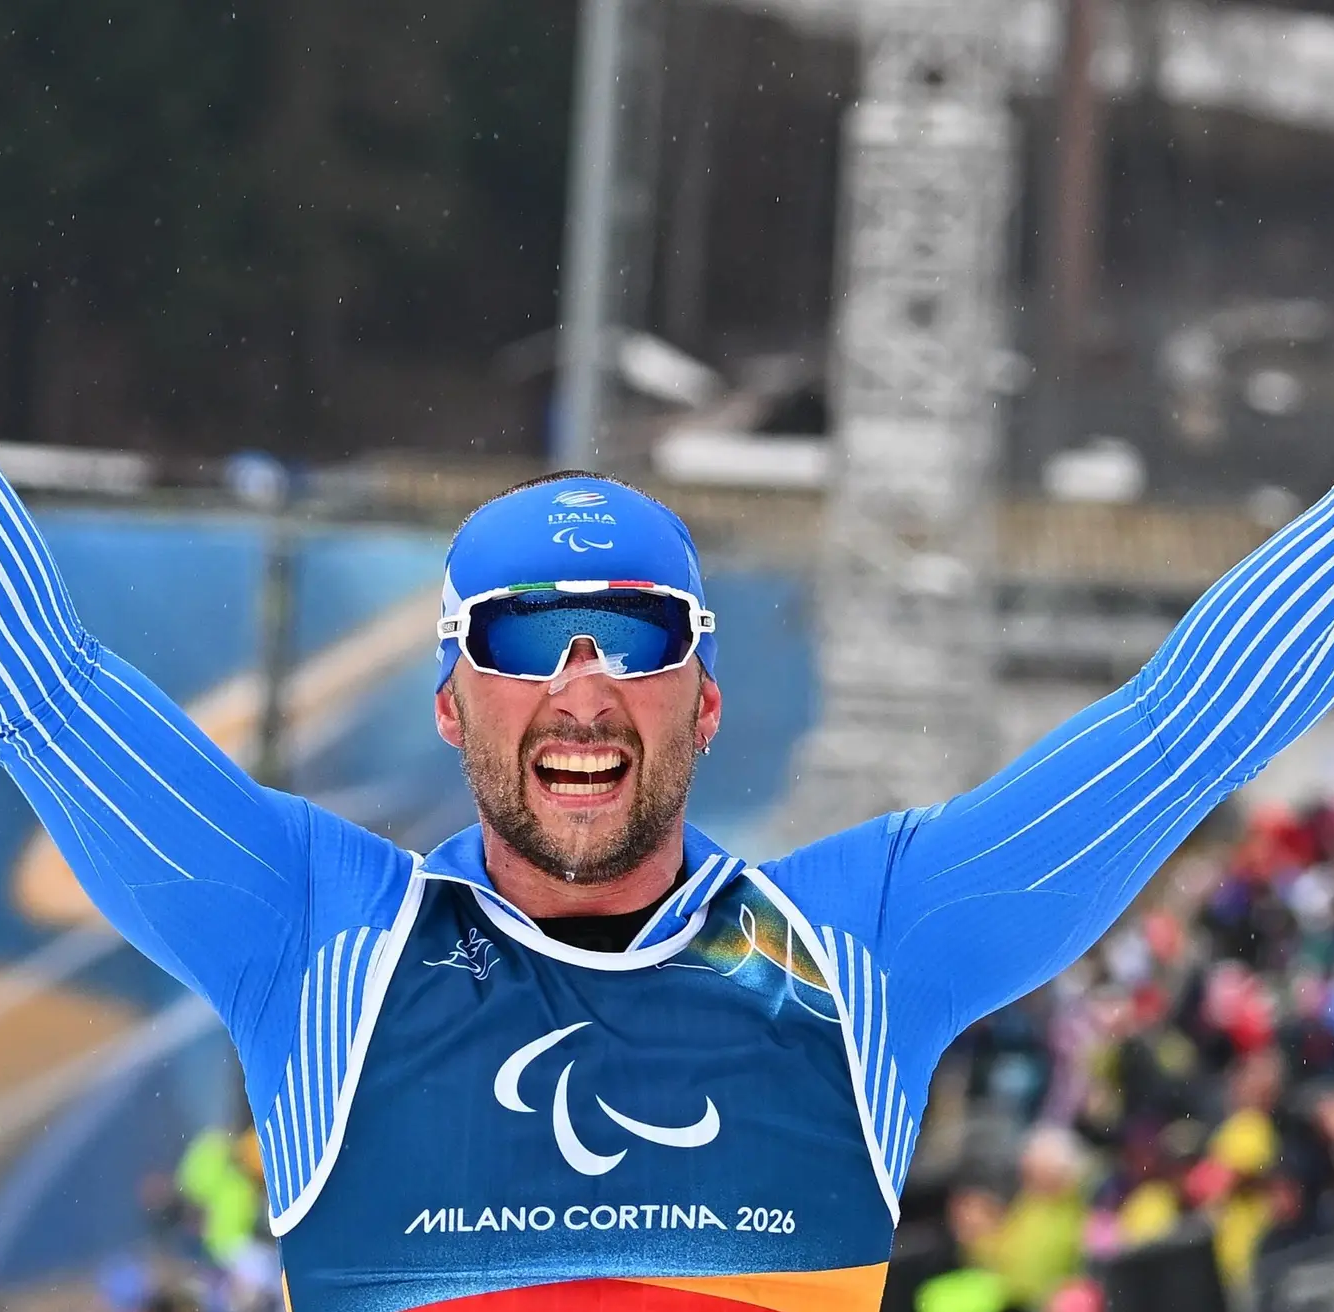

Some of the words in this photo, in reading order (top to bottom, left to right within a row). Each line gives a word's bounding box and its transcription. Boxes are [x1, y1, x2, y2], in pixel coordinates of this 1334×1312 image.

[548, 512, 616, 522] ITALIA
[404, 1206, 556, 1234] MILANO
[563, 1204, 728, 1230] CORTINA
[735, 1207, 796, 1234] 2026
